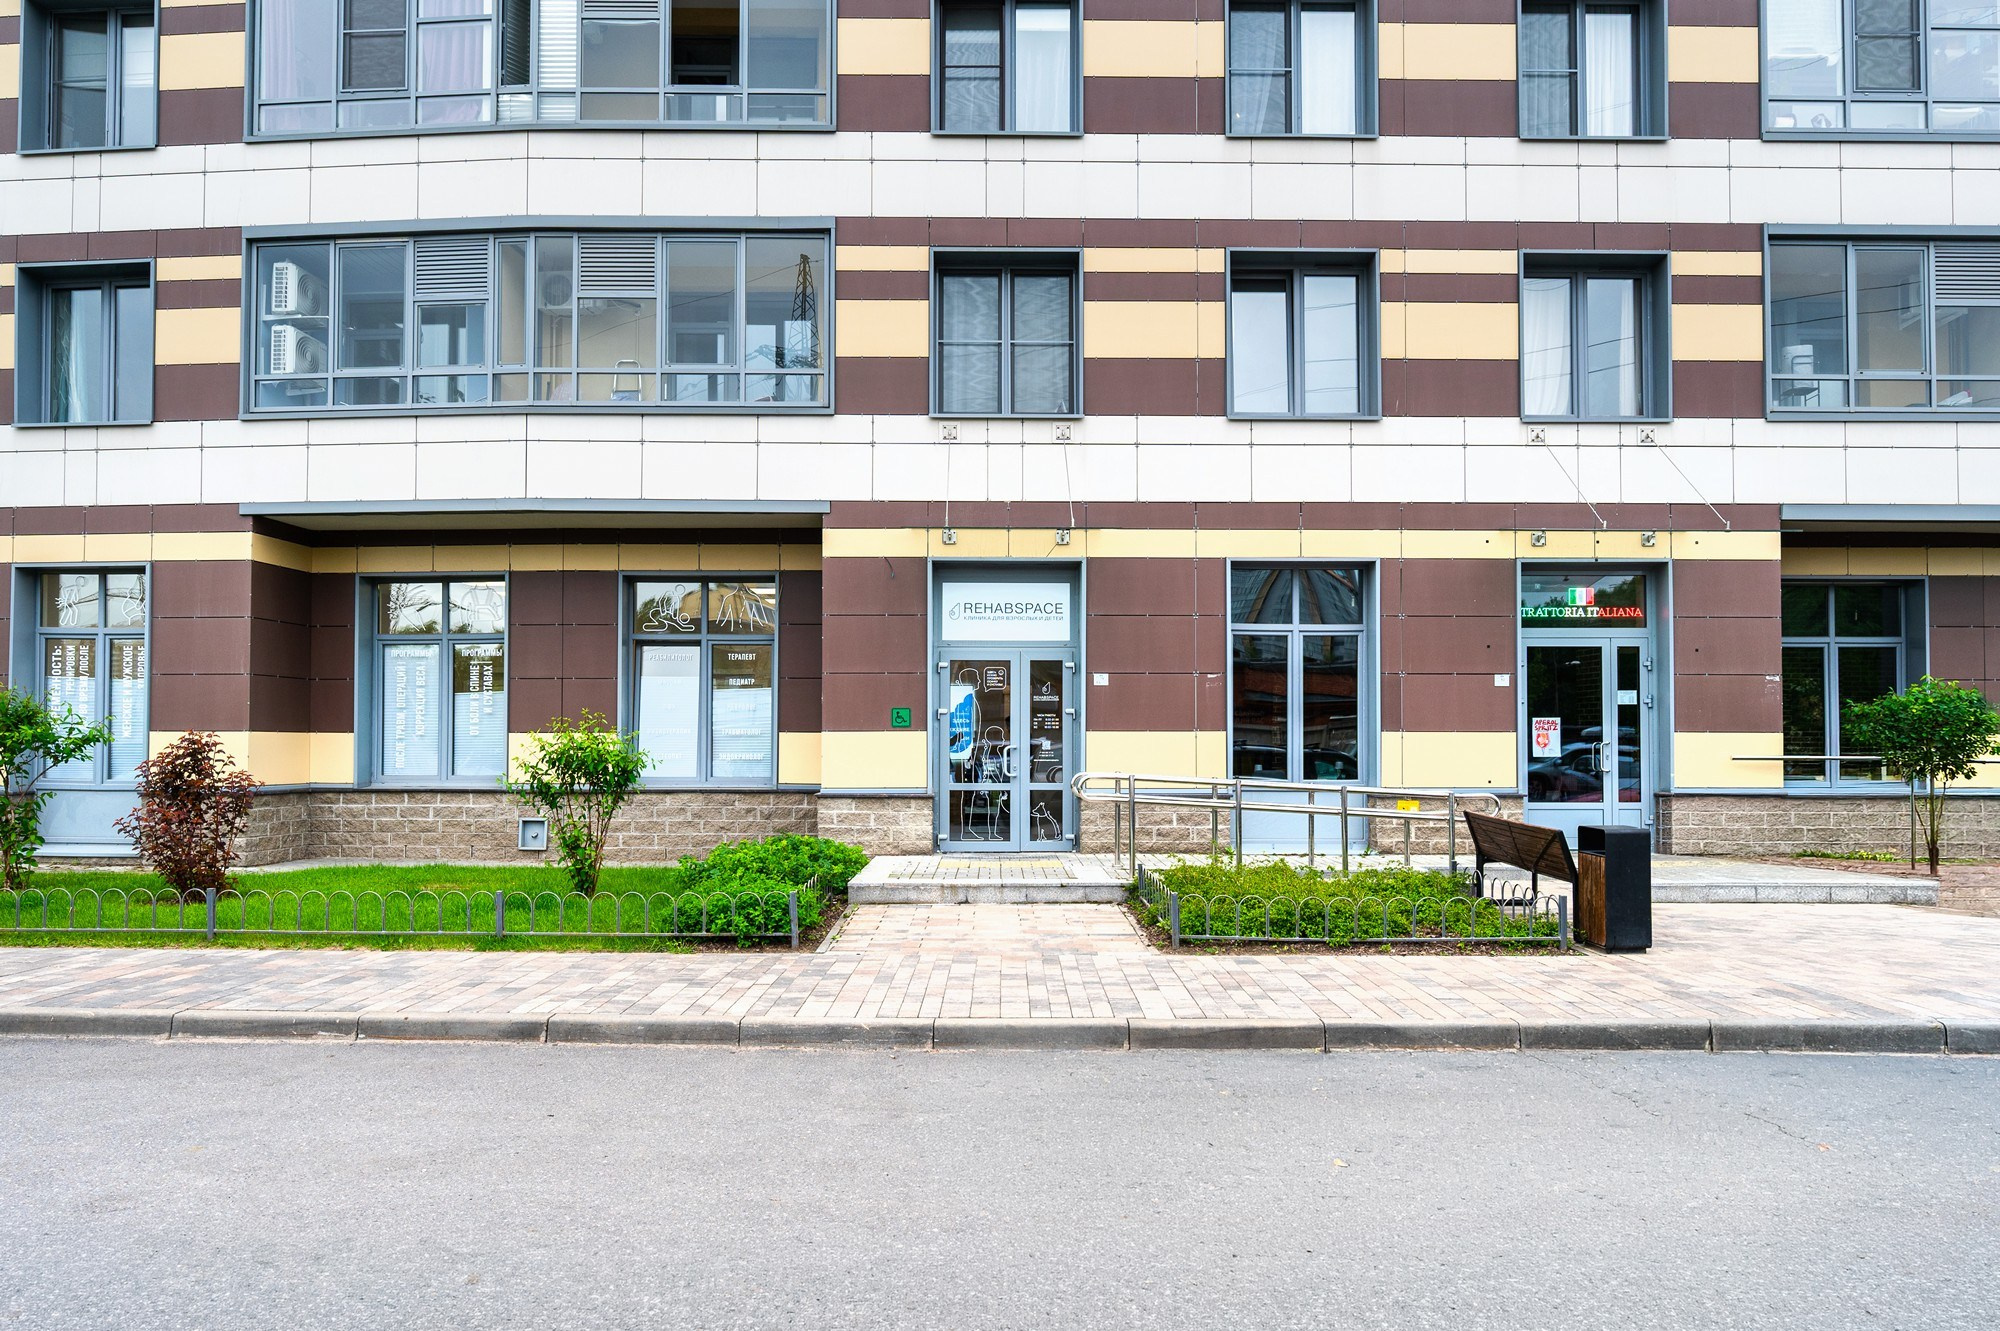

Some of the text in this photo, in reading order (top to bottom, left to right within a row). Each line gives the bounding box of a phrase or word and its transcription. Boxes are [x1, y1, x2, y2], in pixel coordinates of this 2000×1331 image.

[963, 602, 1064, 615] REHABSPACE
[1520, 607, 1643, 618] TRATTORIA ITALIANA
[391, 648, 432, 658] ПРОГРАММЫ
[461, 648, 503, 657] ПРОГРАММЫ
[727, 653, 757, 661] ТЕРАПЕВТ
[66, 645, 75, 696] ТРЕНИРОВКИ
[123, 645, 133, 688] МУЖСКОЕ
[470, 665, 479, 691] СПИНЕ
[396, 665, 407, 708] ОПЕРАЦИЙ
[483, 664, 493, 705] СУСТАВАХ
[728, 678, 755, 686] ПЕДИАТР
[415, 665, 426, 737] КОРРЕКЦИЯ ВЕСА
[469, 701, 479, 724] БОЛИ
[122, 697, 133, 738] ЖЕНСКОЕ
[470, 725, 479, 736] ОТ
[395, 741, 405, 769] ПОСЛЕ
